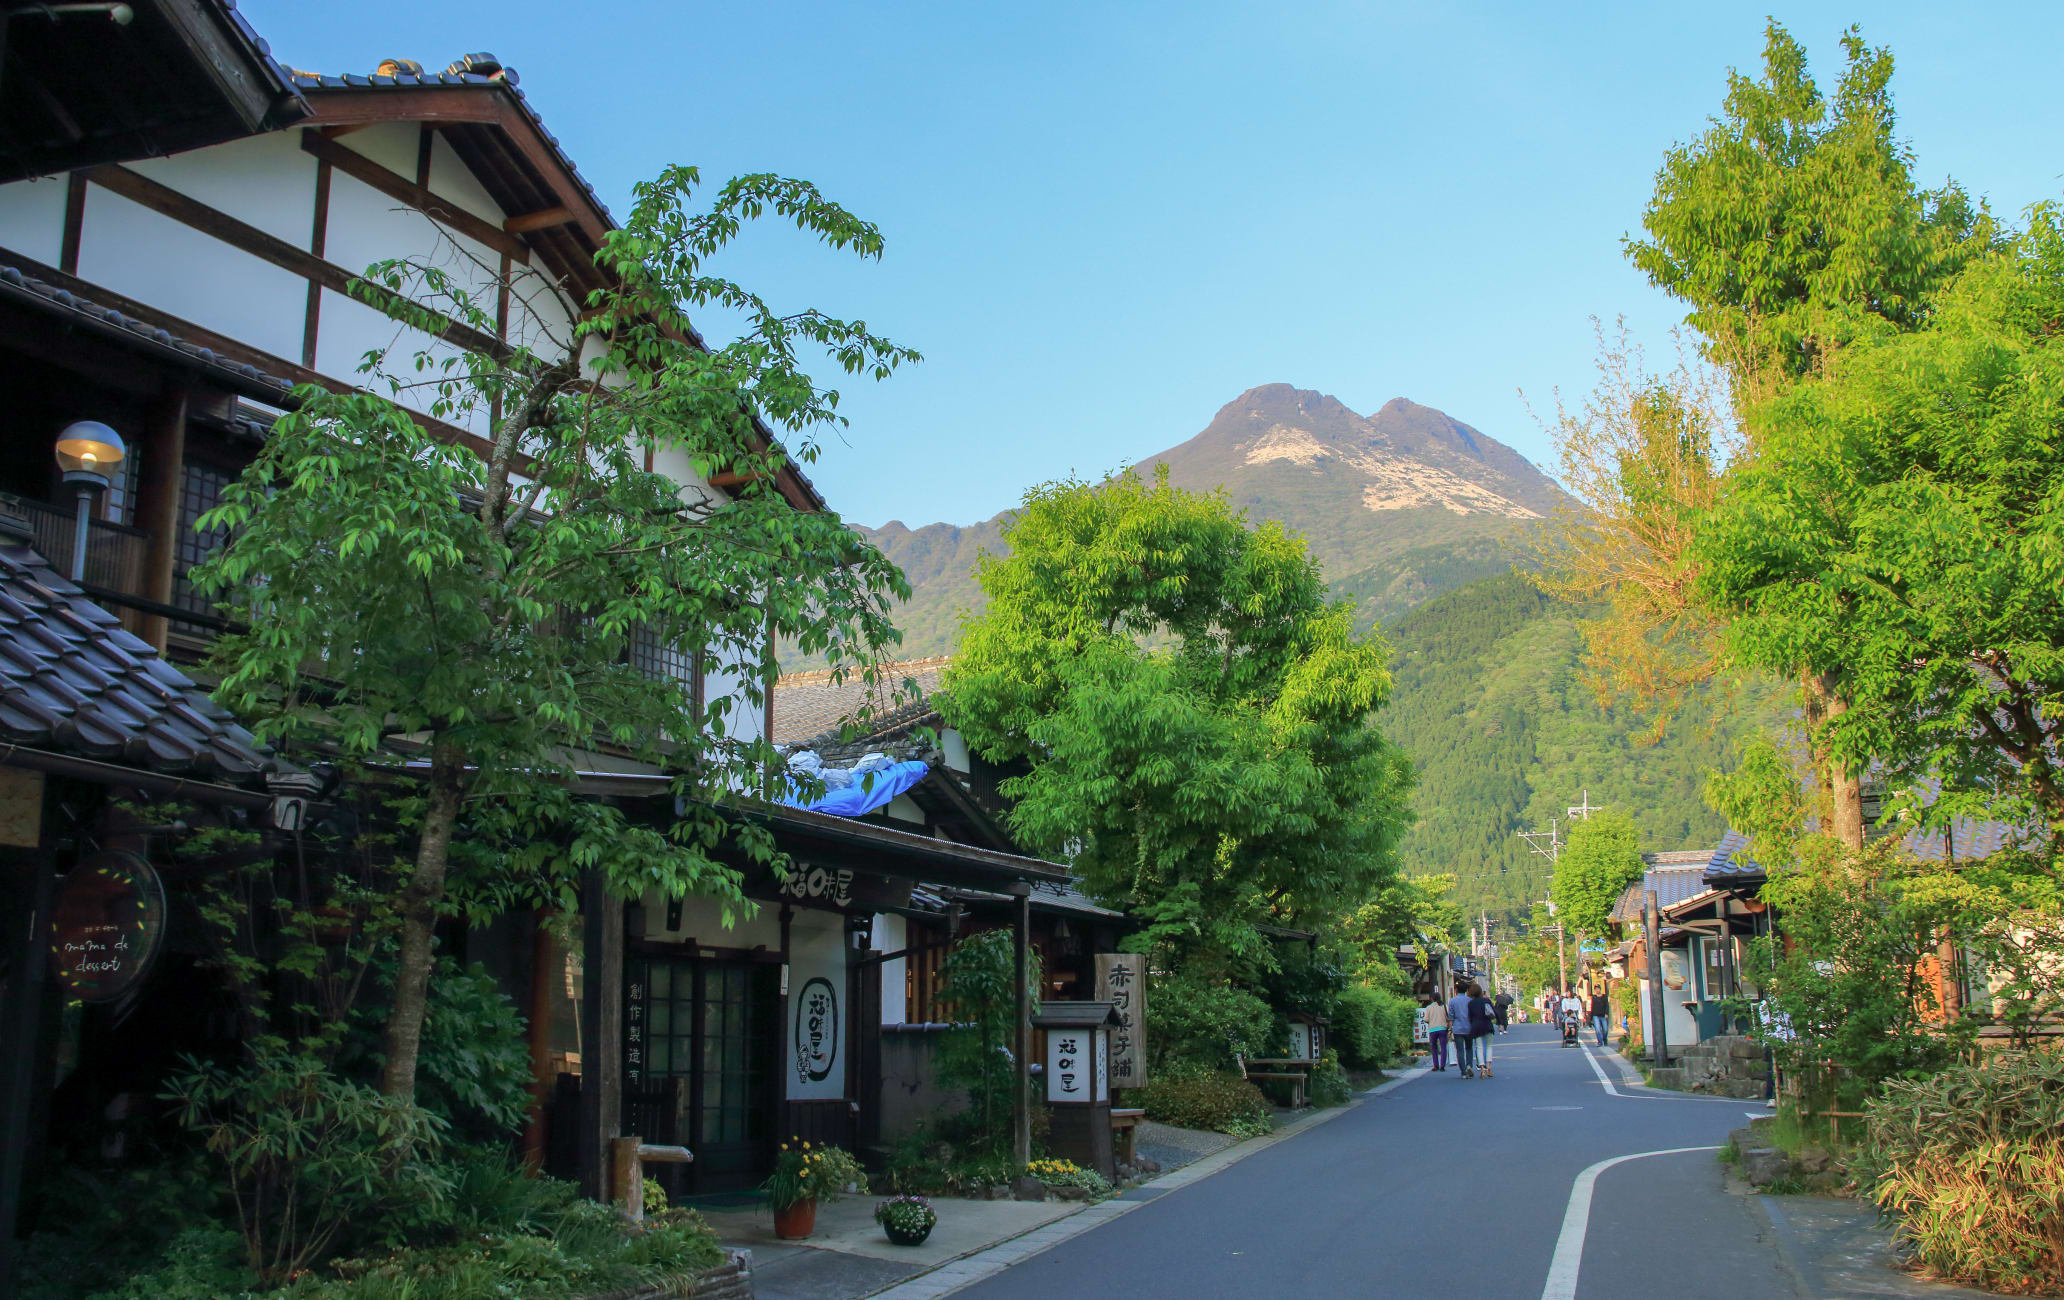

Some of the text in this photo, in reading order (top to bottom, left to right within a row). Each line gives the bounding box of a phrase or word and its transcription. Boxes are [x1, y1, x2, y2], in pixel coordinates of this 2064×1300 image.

[75, 954, 121, 972] dessert
[1059, 1039, 1080, 1093] 福味屋
